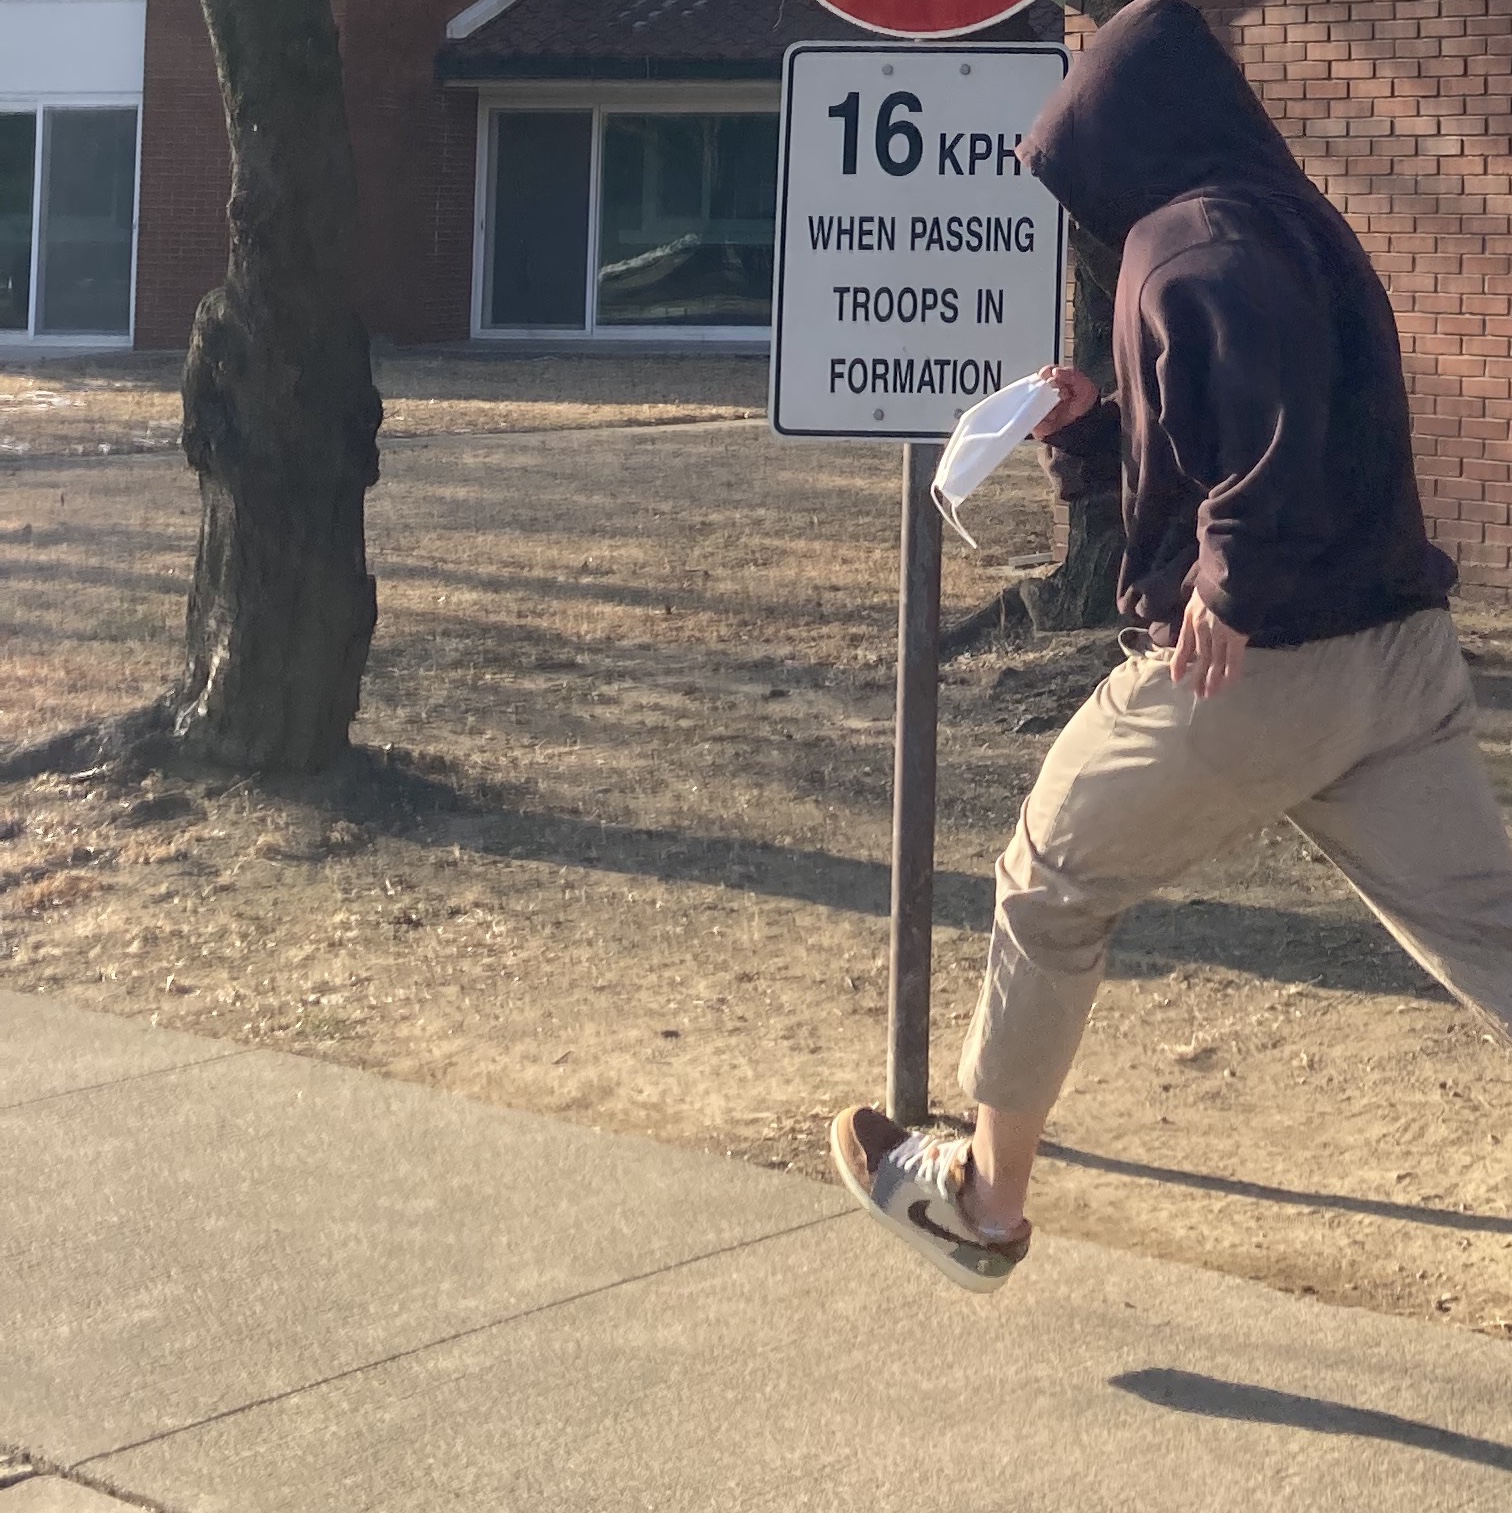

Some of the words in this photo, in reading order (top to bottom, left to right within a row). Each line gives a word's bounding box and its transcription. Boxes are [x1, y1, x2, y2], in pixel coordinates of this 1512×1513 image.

[828, 91, 923, 176] 16
[938, 133, 1022, 176] KPH
[808, 215, 895, 251] WHEN
[910, 216, 1034, 253] PASSING
[833, 287, 959, 323] TROOPS
[976, 289, 1003, 323] IN
[830, 358, 1002, 395] FORMATION
